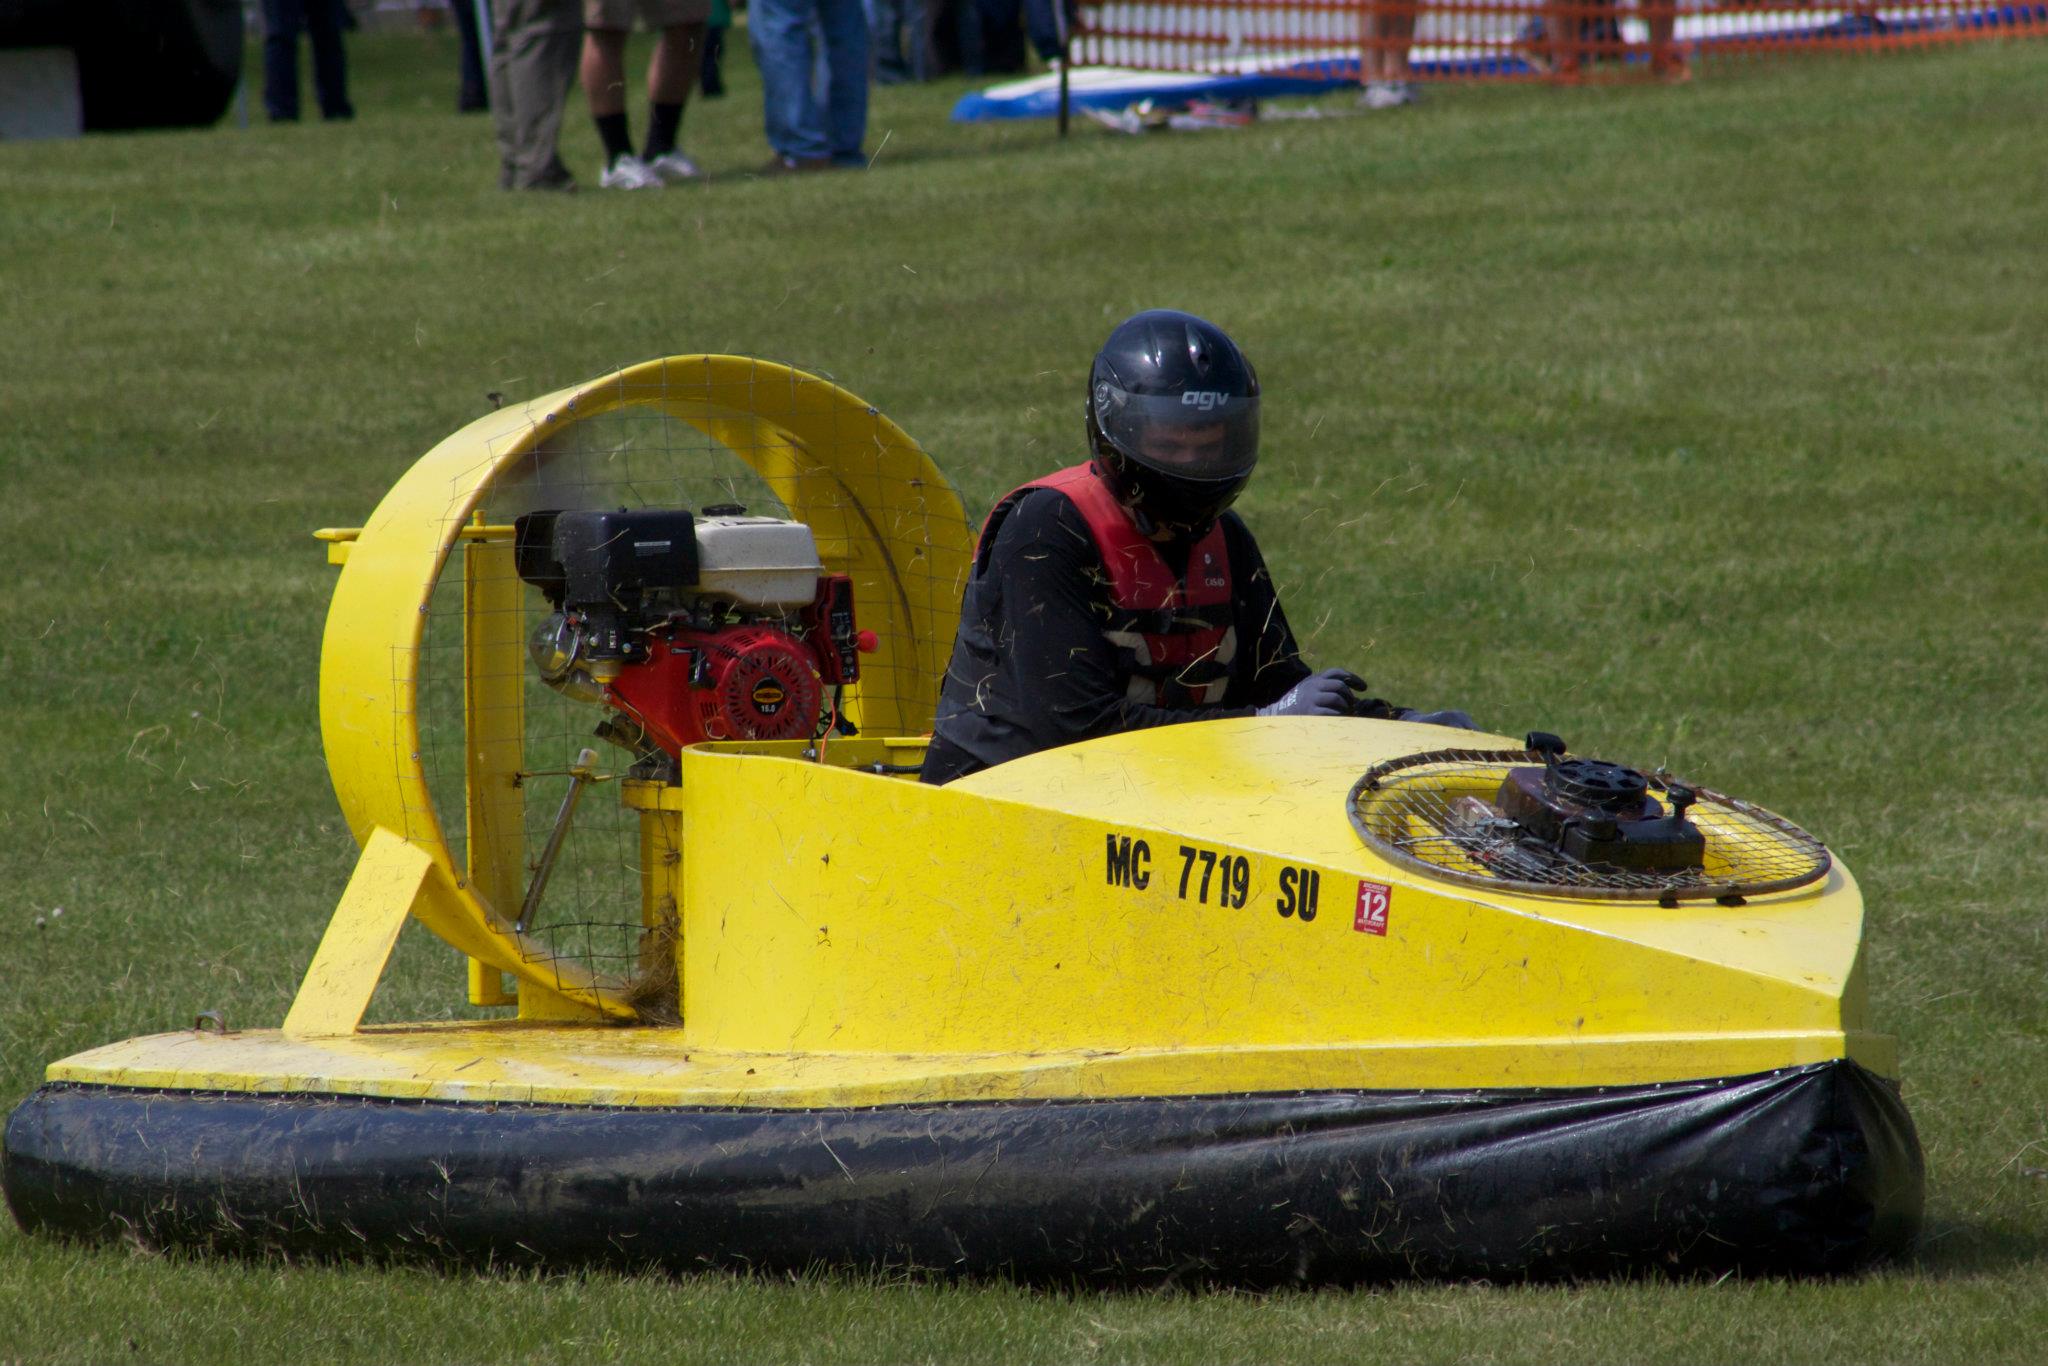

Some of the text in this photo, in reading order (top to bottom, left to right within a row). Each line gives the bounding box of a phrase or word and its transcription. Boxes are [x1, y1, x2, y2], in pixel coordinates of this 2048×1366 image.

[1182, 391, 1230, 411] agv
[1106, 833, 1320, 922] MC 7719 SU
[1361, 891, 1387, 922] 12
